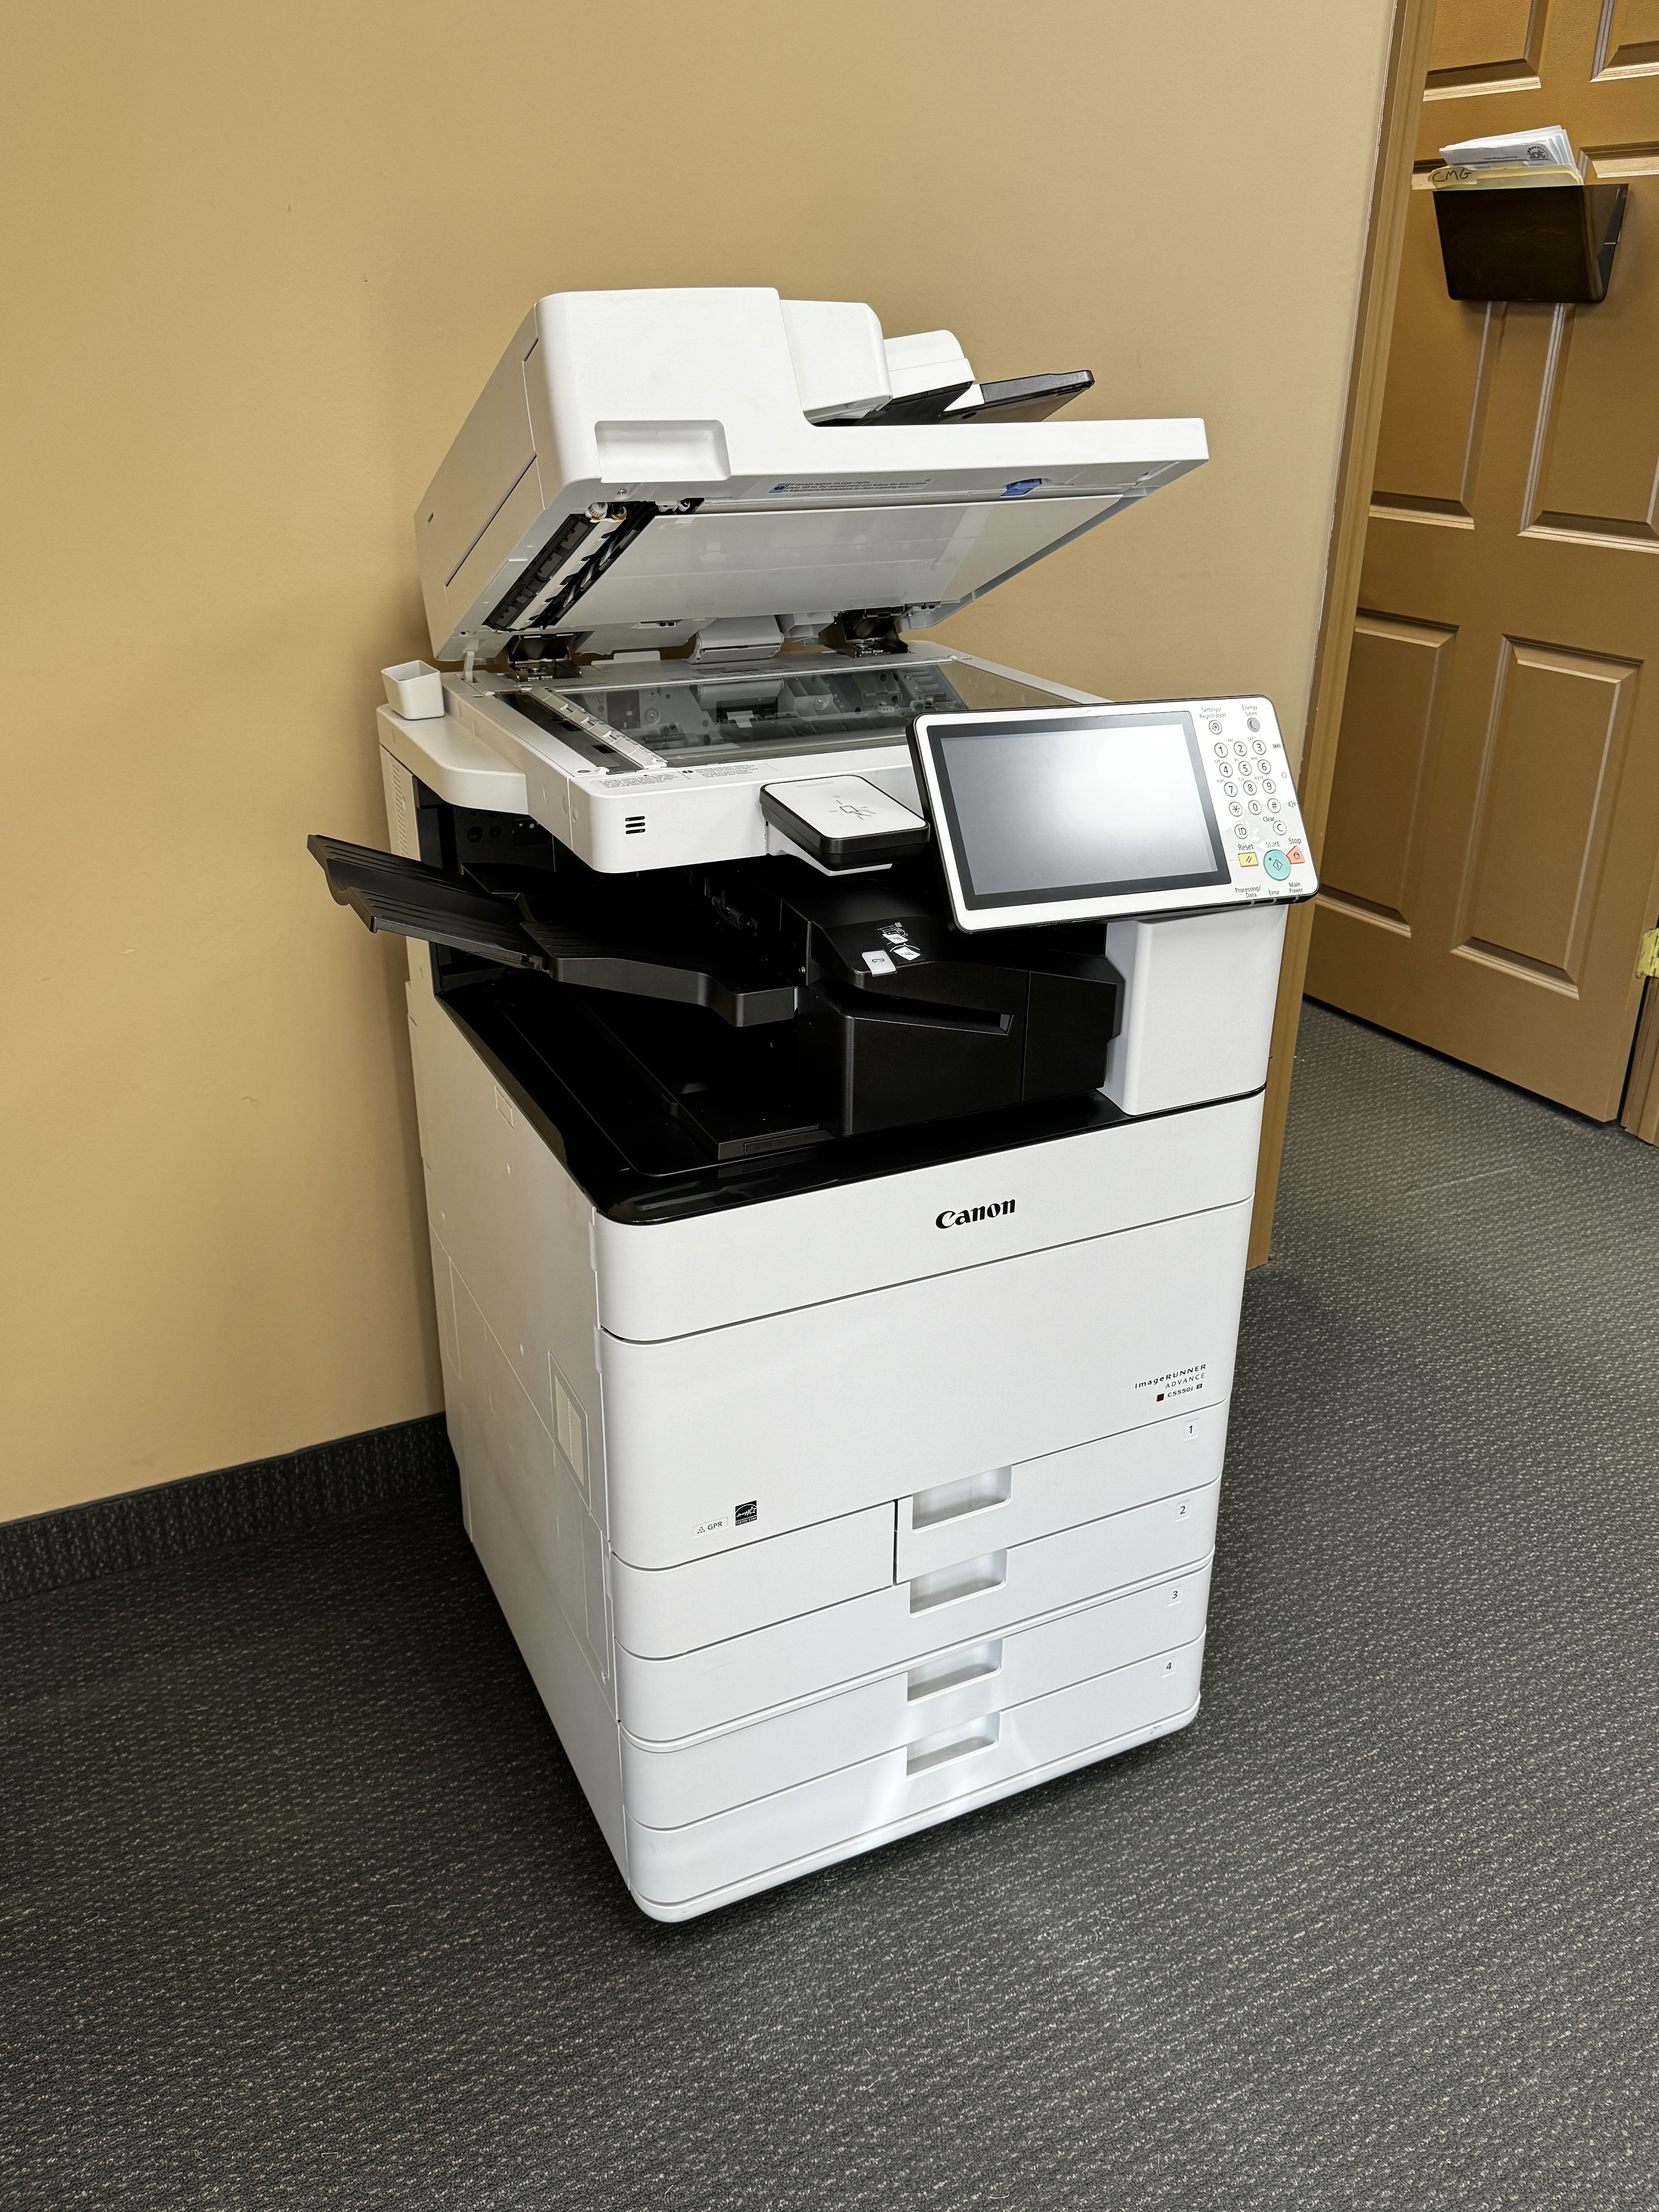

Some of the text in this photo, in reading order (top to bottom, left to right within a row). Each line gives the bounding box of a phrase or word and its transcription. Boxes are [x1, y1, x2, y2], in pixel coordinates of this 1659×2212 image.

[1432, 169, 1471, 182] CMG
[1238, 827, 1246, 836] ID
[935, 1199, 1015, 1229] Canon
[1166, 1373, 1205, 1389] ADVANCE
[1189, 1425, 1192, 1434] 1
[1180, 1505, 1185, 1514] 2
[708, 1521, 722, 1530] GPR
[1172, 1591, 1178, 1599] 3
[1166, 1662, 1172, 1670] 4
